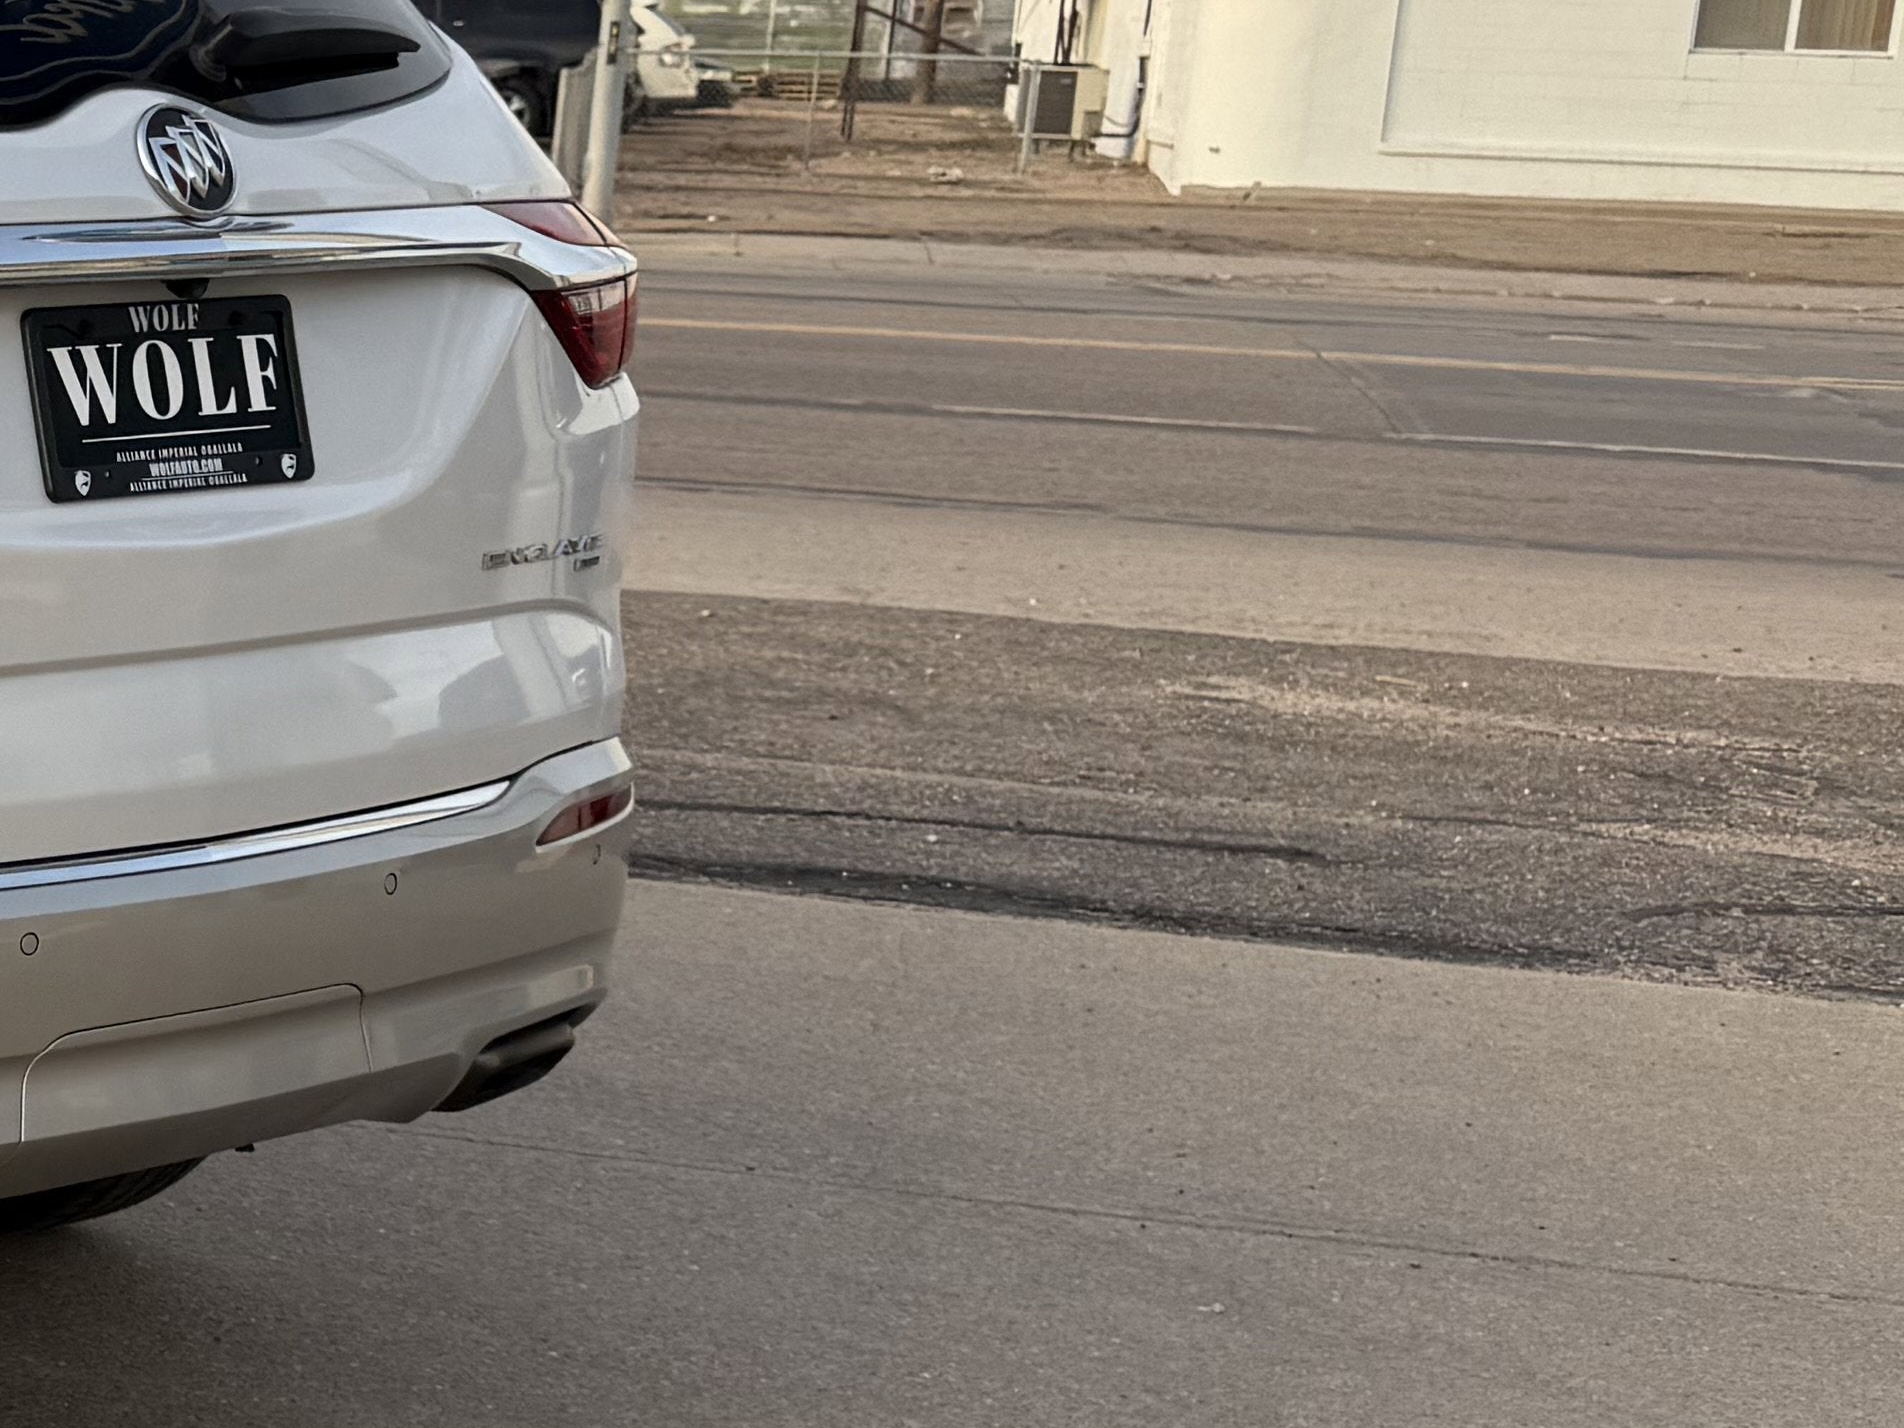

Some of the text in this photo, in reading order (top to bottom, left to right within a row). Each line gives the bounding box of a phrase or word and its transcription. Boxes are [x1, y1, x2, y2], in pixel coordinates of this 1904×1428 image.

[128, 302, 200, 333] WOLF
[46, 333, 279, 427] WOLF
[116, 449, 156, 462] ALLIANCE
[158, 446, 198, 459] IMPERIAL
[148, 457, 224, 477] WOLFAUTO.COM
